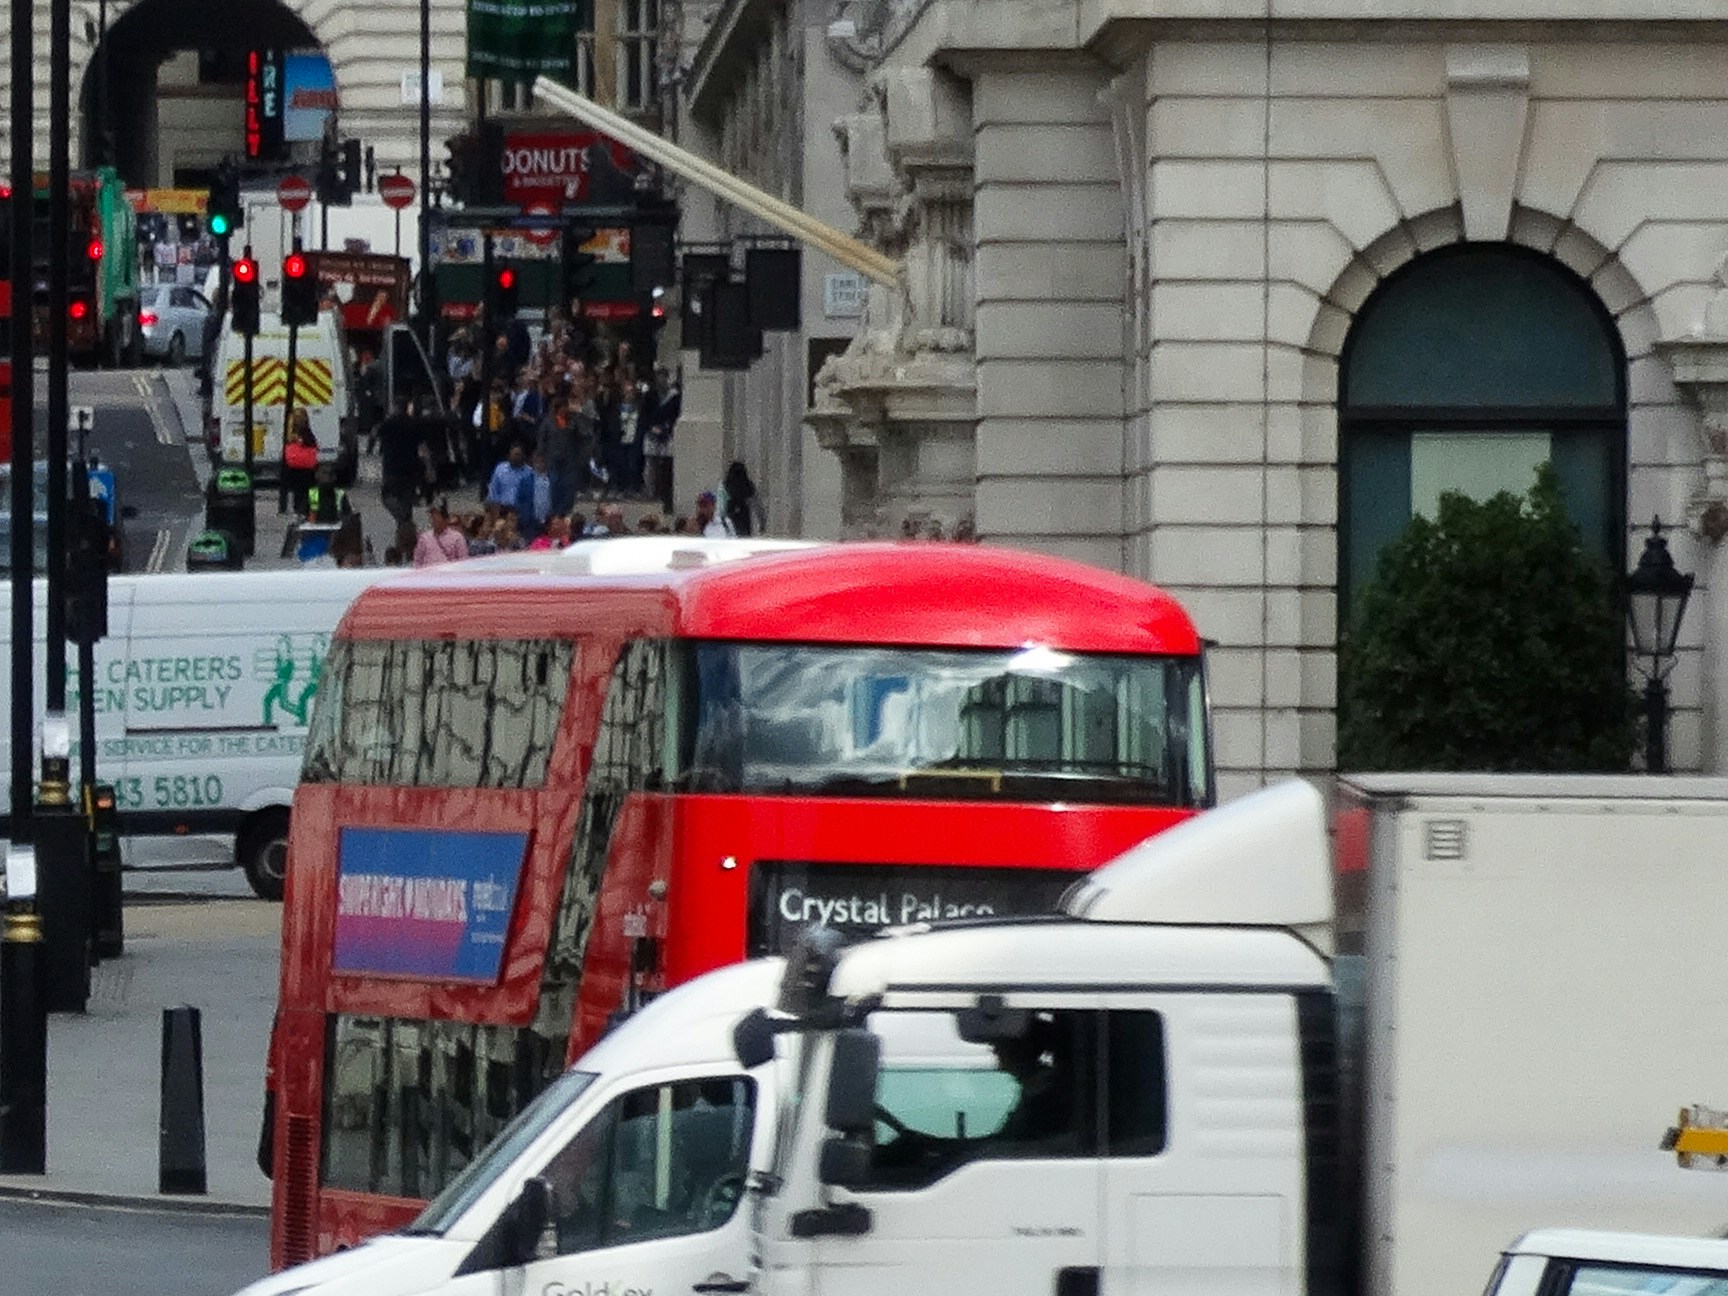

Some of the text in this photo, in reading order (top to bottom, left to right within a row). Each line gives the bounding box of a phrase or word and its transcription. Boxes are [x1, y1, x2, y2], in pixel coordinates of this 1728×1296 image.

[106, 656, 242, 685] CATERERS
[135, 685, 233, 713] SUPPLY
[104, 738, 172, 756] SERVICE
[178, 737, 212, 755] FOR
[219, 736, 246, 754] THE
[154, 772, 224, 807] 5810
[779, 887, 890, 929] Crystal
